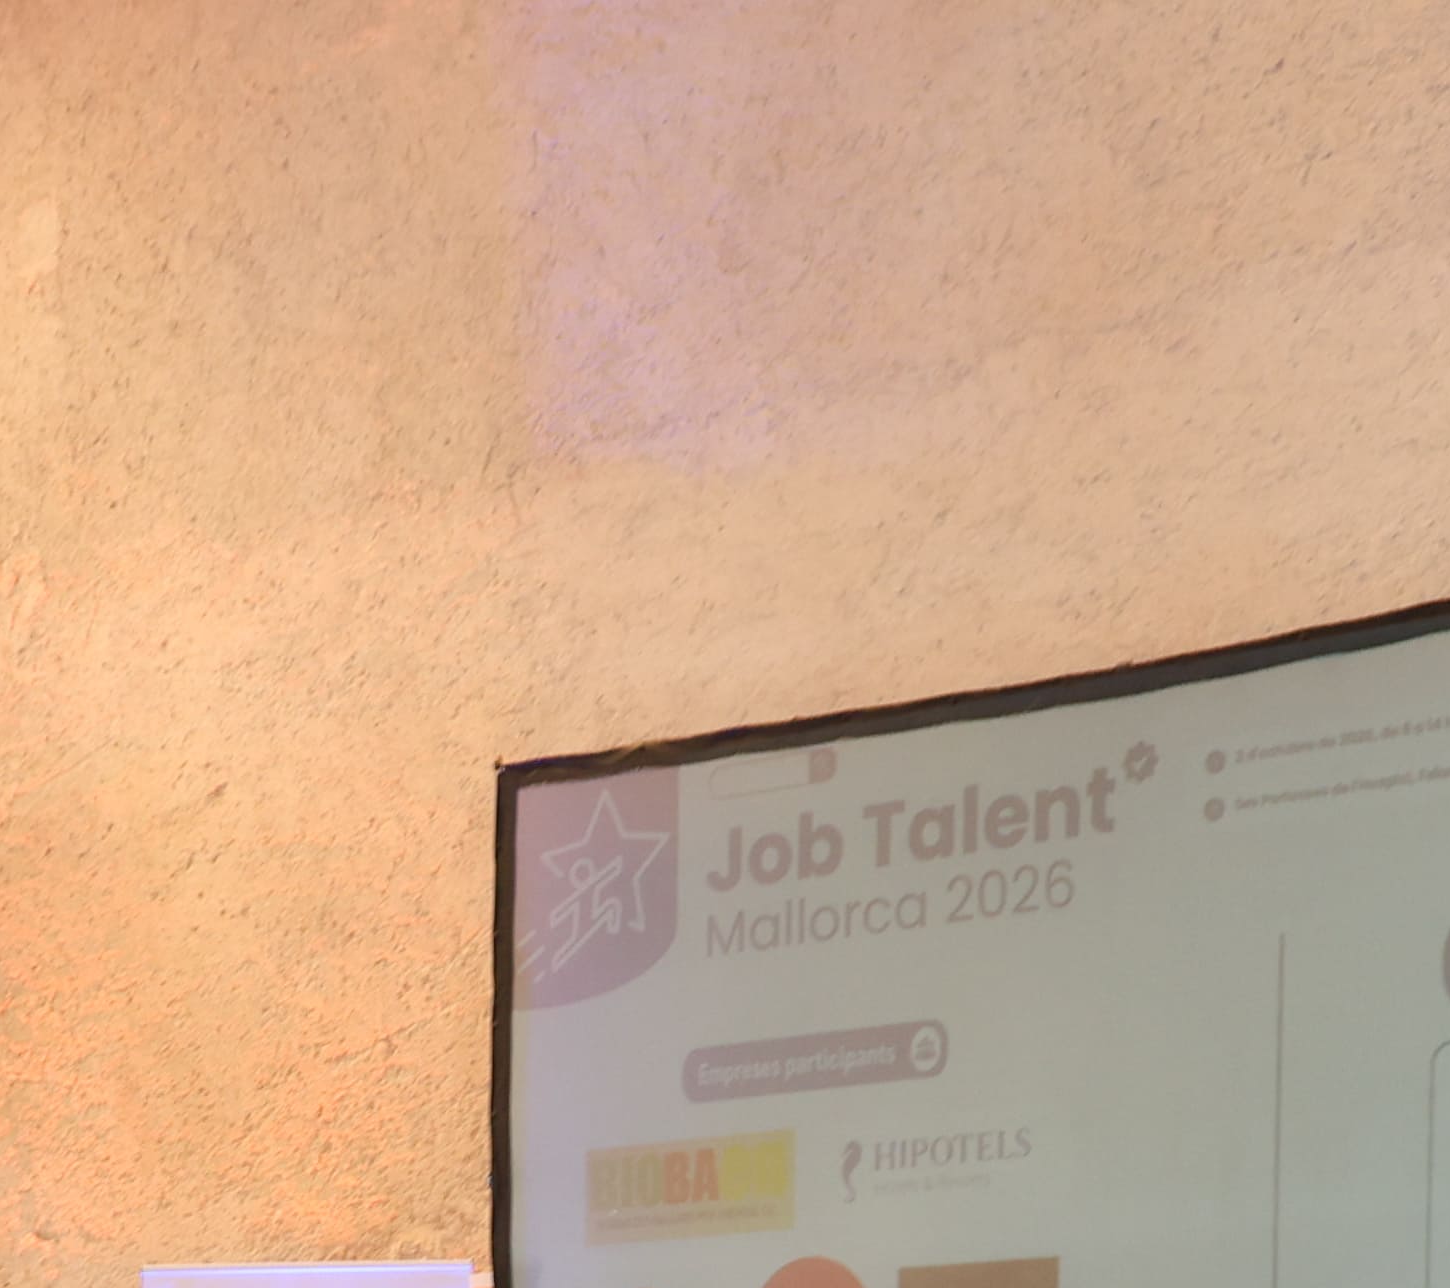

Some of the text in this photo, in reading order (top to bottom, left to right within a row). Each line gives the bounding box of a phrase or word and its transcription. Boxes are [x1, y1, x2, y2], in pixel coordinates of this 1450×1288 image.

[707, 765, 1116, 892] Job Talent
[705, 860, 1077, 958] Mallorca 2026
[696, 1043, 897, 1088] Empreses participants
[873, 1126, 1033, 1172] HIPOTELS
